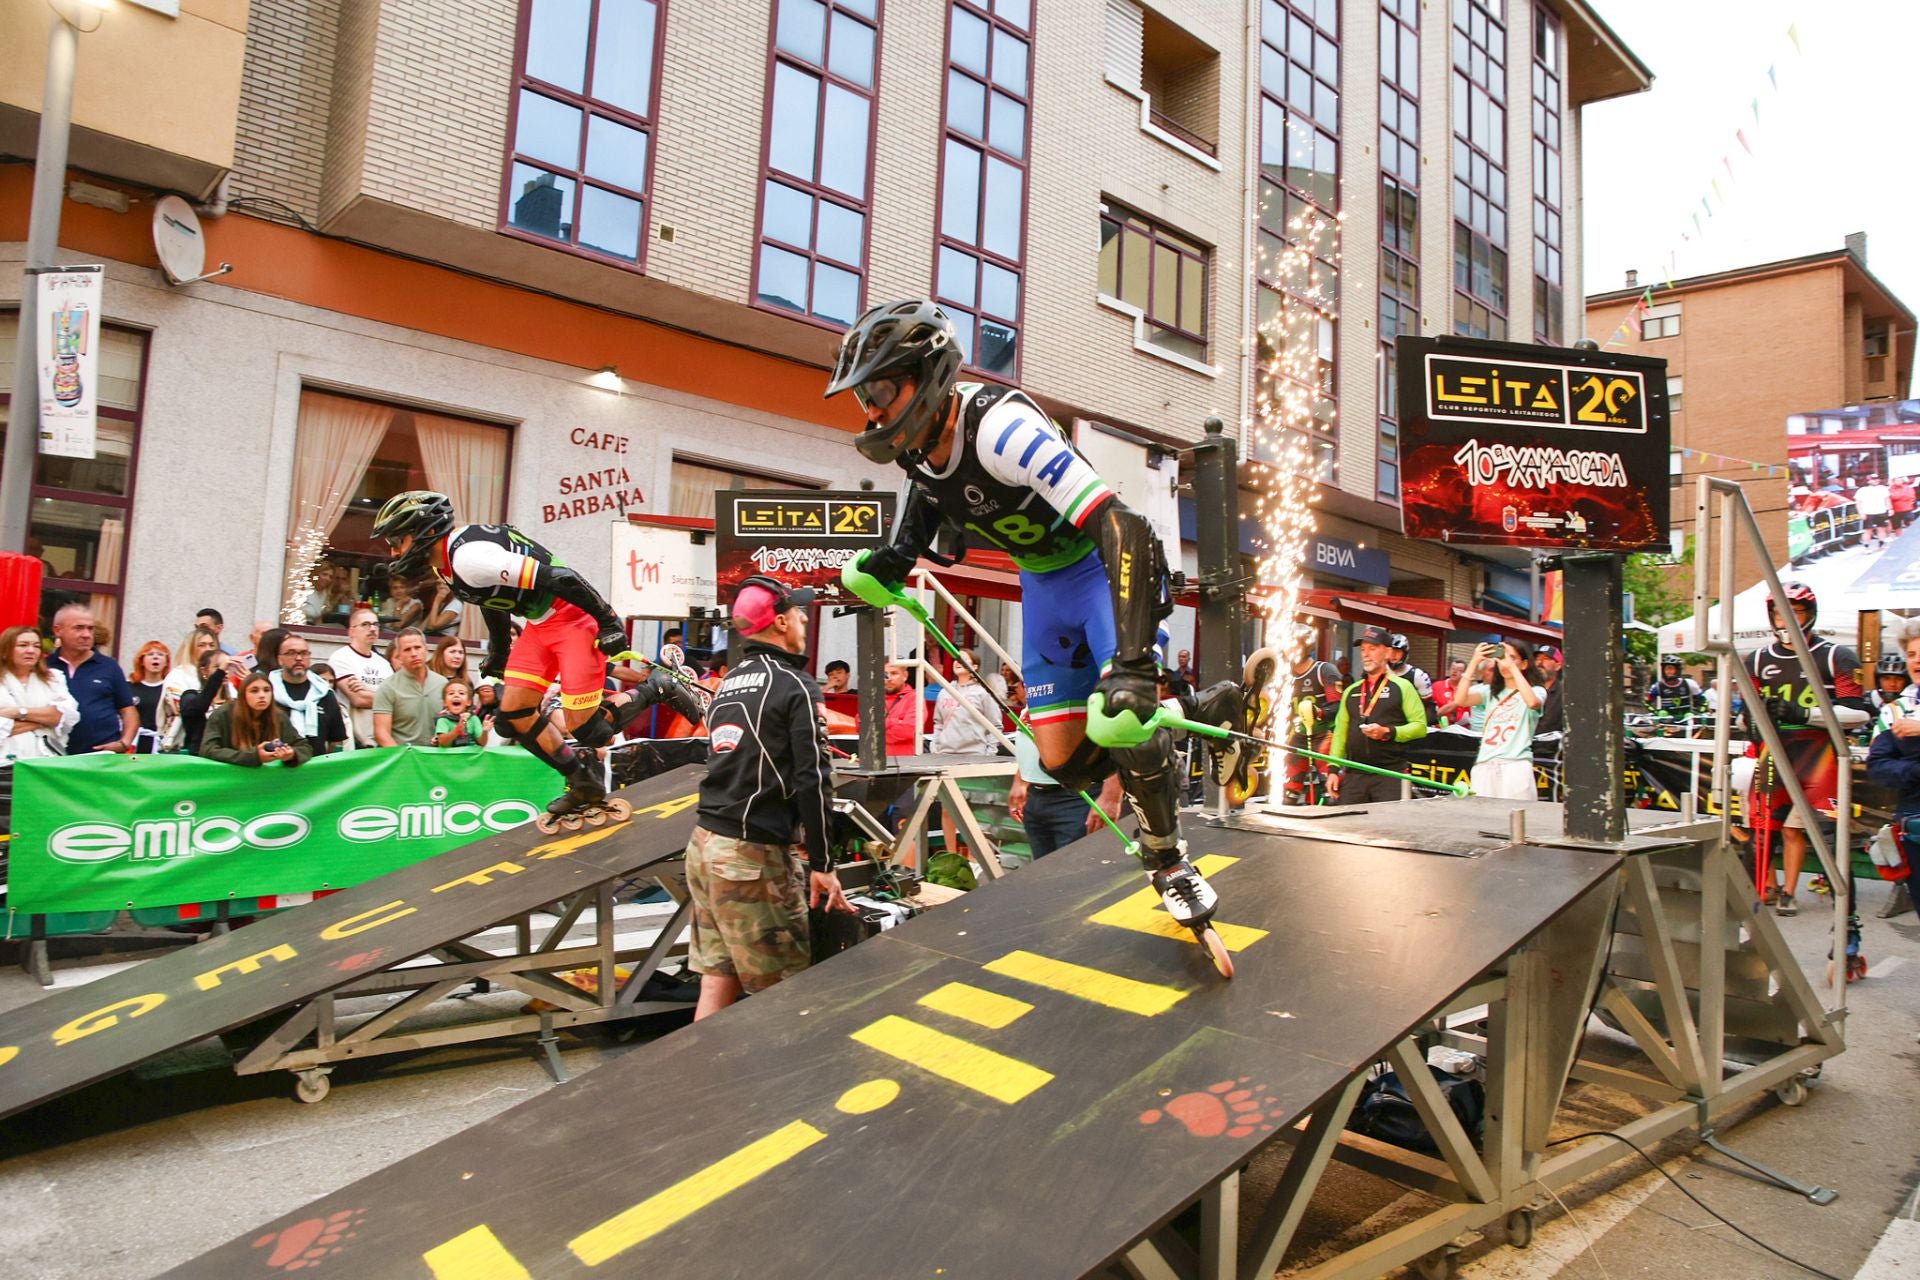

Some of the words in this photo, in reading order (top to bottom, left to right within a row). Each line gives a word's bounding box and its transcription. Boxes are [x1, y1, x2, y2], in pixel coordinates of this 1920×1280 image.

[1437, 403, 1460, 411] CLUB
[1462, 405, 1508, 415] DEPORTIVO
[1509, 408, 1561, 419] LEITARIEGOS
[993, 417, 1075, 488] ITA
[1505, 446, 1628, 489] XAMASCADA
[559, 467, 630, 495] SANTA
[542, 487, 645, 523] BARBARA
[785, 548, 867, 573] XAMASCA
[1316, 542, 1356, 568] BBVA
[1119, 552, 1132, 600] LEKI
[717, 687, 759, 699] ACING
[49, 800, 311, 863] emico
[338, 785, 541, 842] emico
